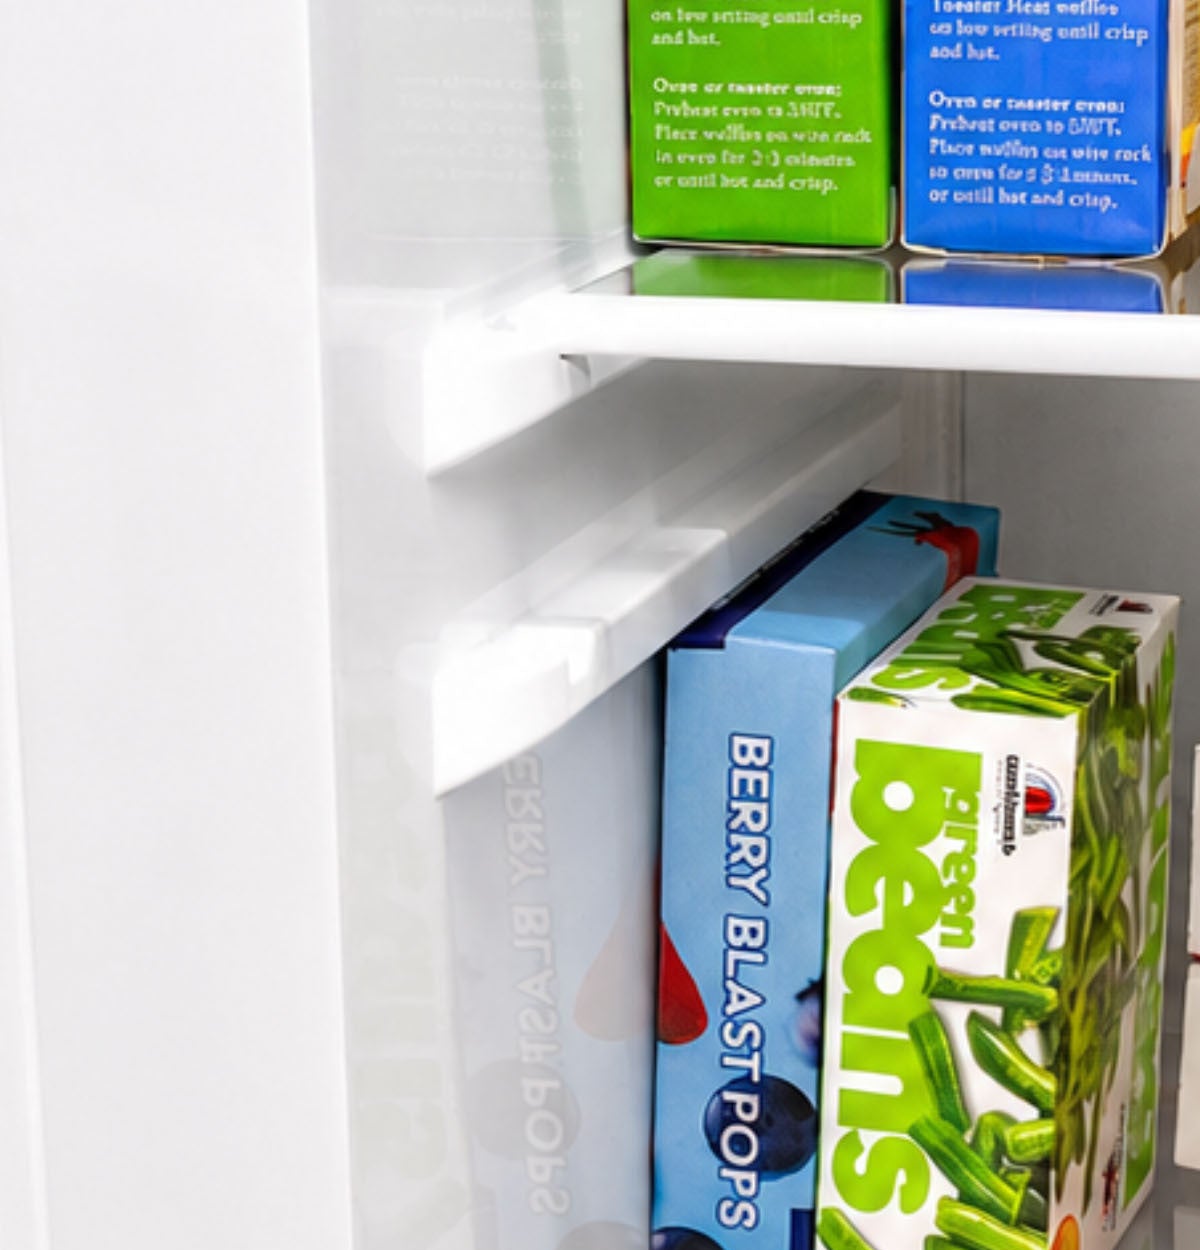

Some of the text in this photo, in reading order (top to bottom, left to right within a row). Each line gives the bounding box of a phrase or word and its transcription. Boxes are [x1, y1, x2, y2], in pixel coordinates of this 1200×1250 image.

[716, 732, 772, 1231] BERRY BLAST POPS
[831, 738, 983, 1216] beans
[938, 785, 979, 949] green
